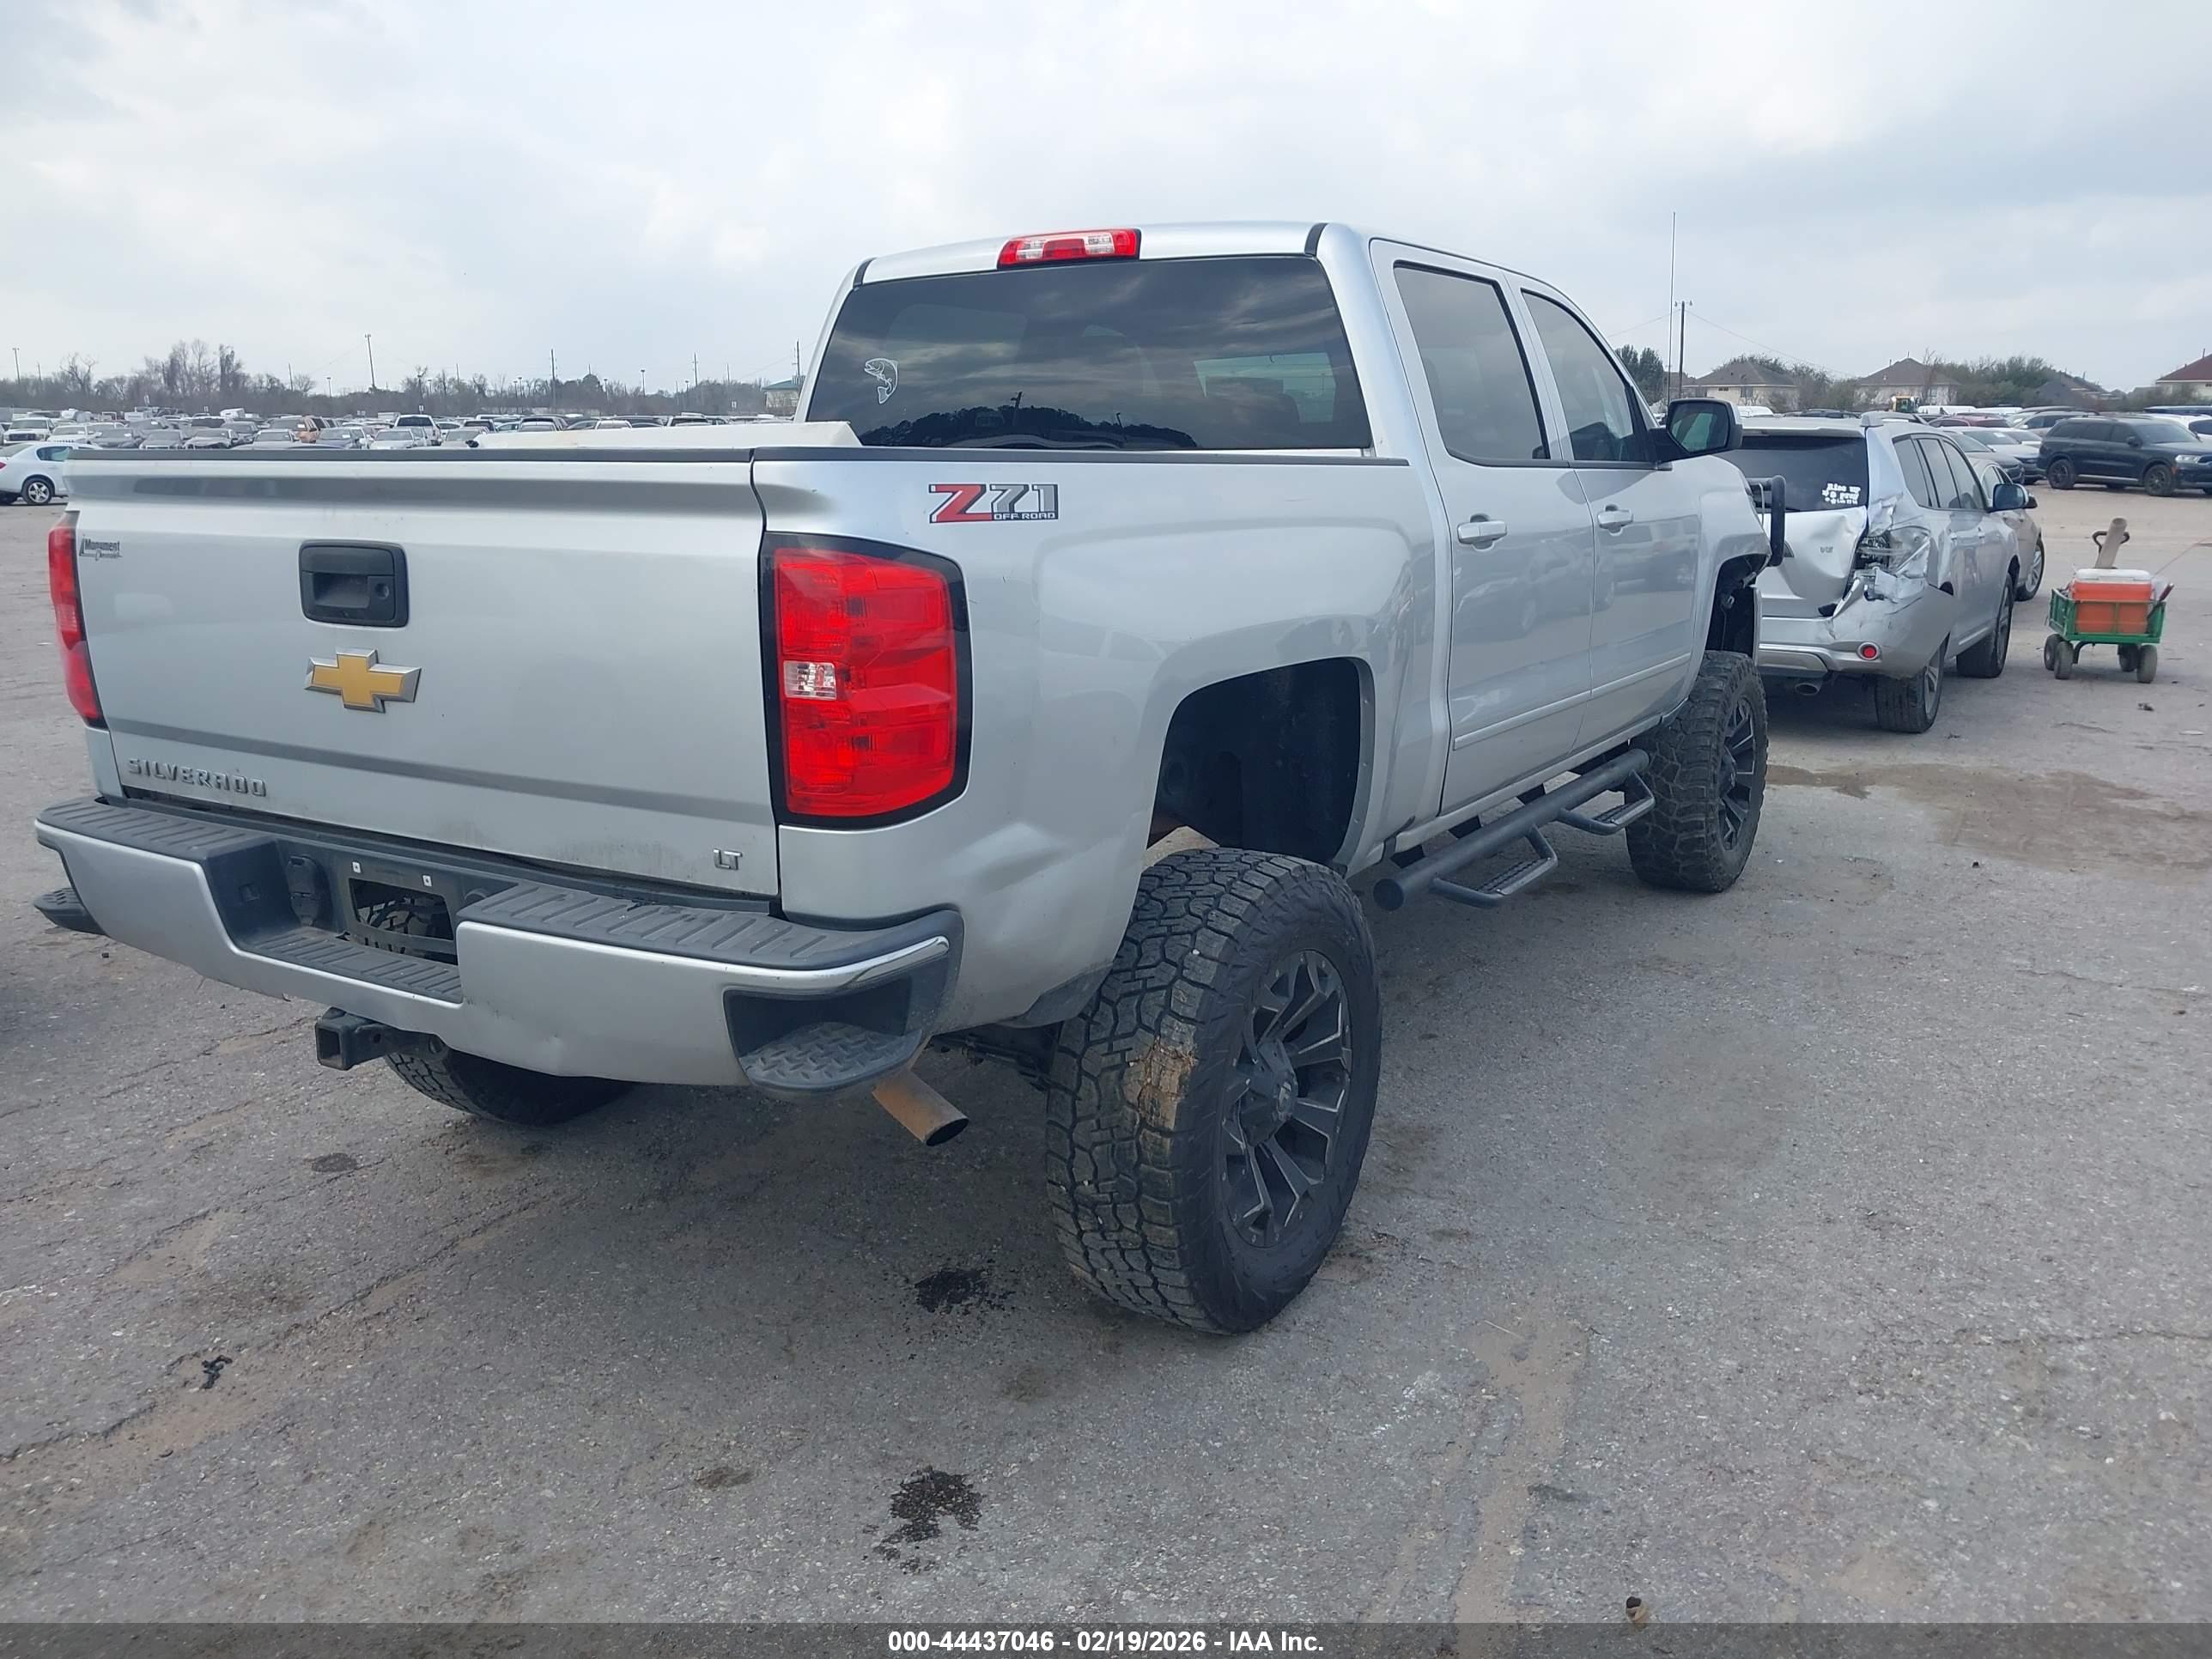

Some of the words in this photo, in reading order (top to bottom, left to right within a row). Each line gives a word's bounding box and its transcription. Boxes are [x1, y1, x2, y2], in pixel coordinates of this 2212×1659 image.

[928, 483, 1059, 523] Z71
[128, 757, 267, 797] SILVERADO
[714, 848, 743, 871] LT
